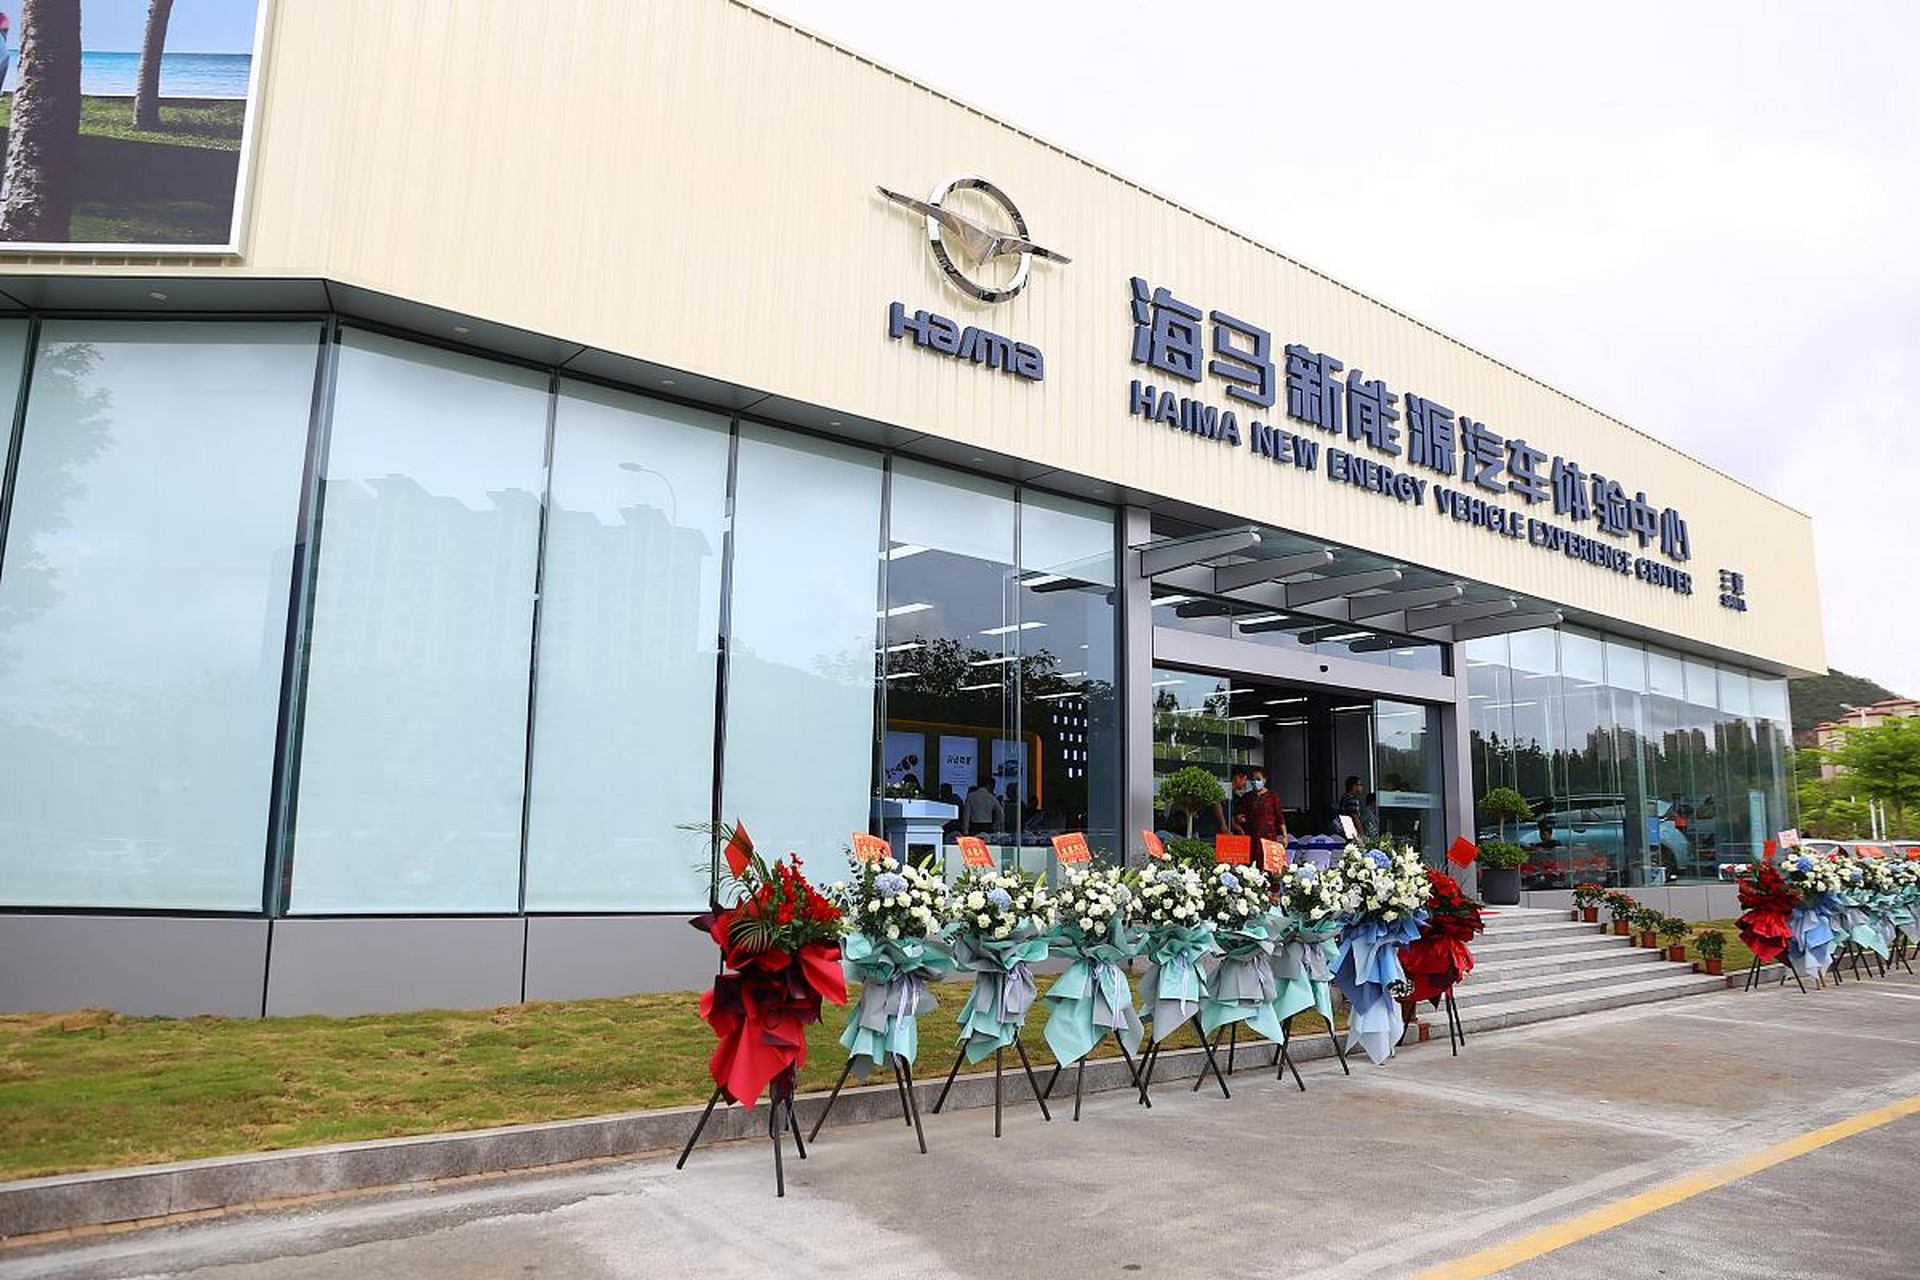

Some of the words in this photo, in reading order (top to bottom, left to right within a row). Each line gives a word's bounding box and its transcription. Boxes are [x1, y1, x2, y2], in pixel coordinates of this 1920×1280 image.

[1130, 276, 1691, 562] 海马新能源汽车体验中心
[1130, 379, 1242, 447] HAIMA
[1251, 420, 1319, 472] NEW
[1327, 447, 1428, 506] ENERGY
[1433, 484, 1525, 540] VEHICLE
[1528, 517, 1633, 576] EXPERIENCE
[1634, 556, 1693, 596] CENTER
